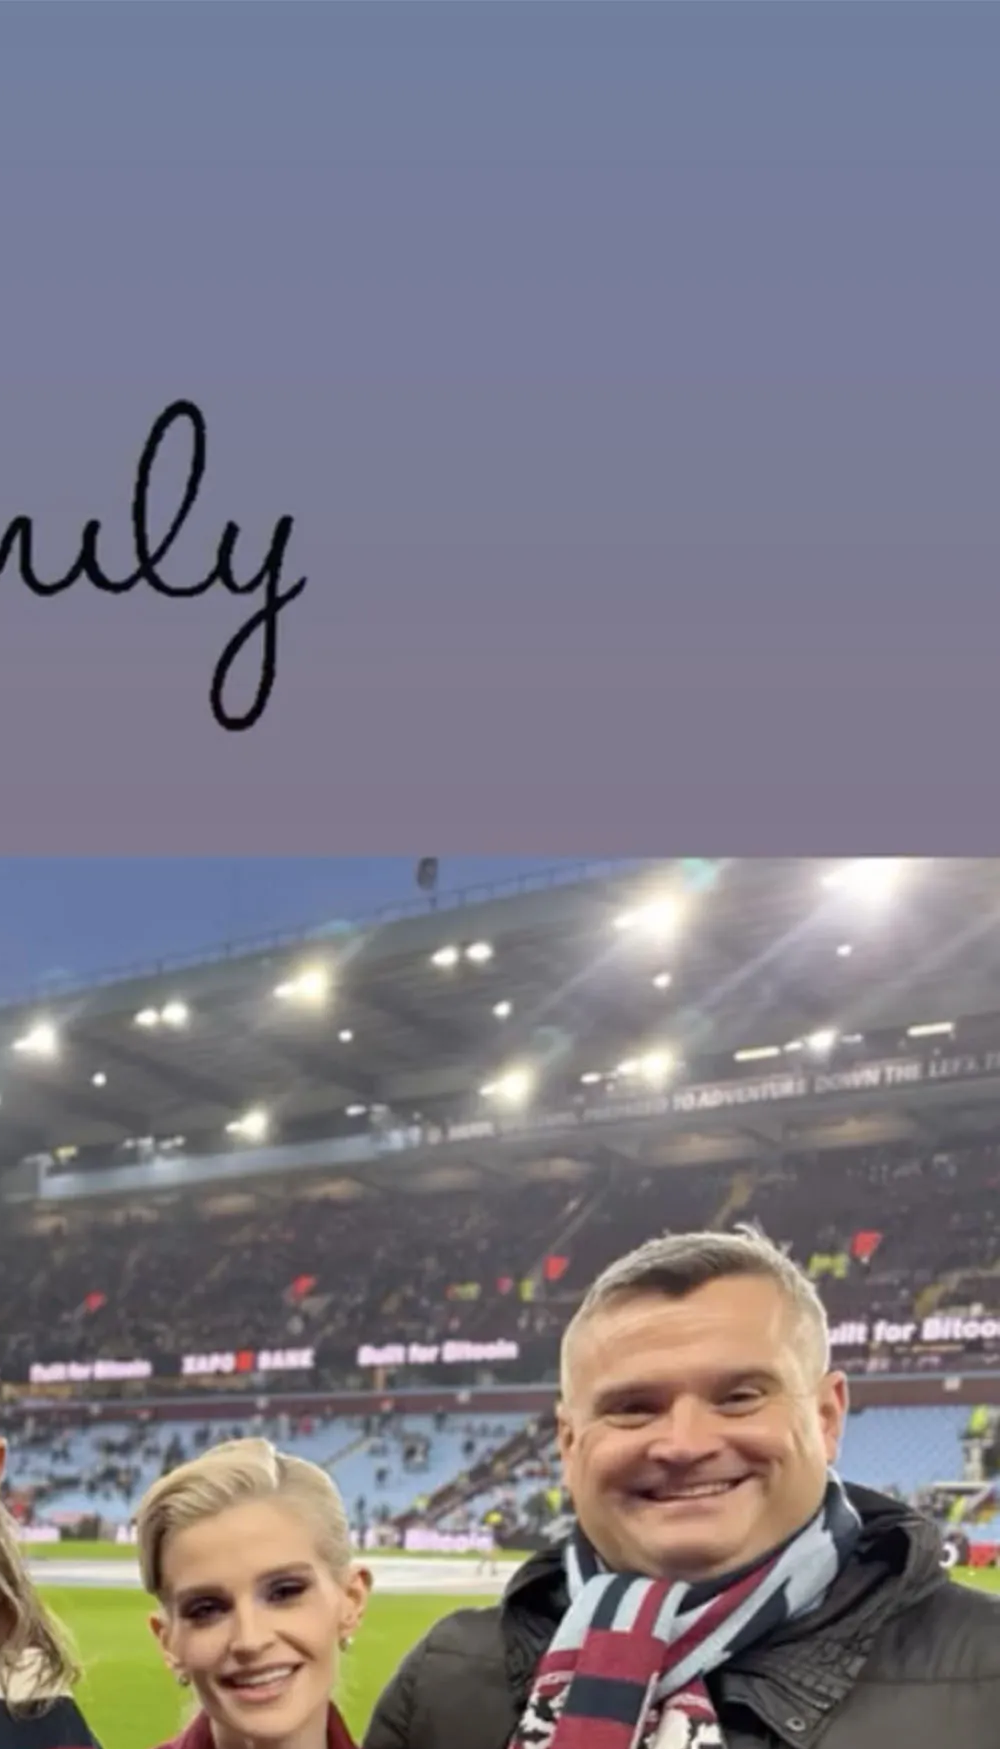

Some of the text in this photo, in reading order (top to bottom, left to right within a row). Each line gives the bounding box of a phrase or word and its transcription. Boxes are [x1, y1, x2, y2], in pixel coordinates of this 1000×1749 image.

[884, 1062, 922, 1083] THE
[829, 1316, 1000, 1346] uilt for Bitco
